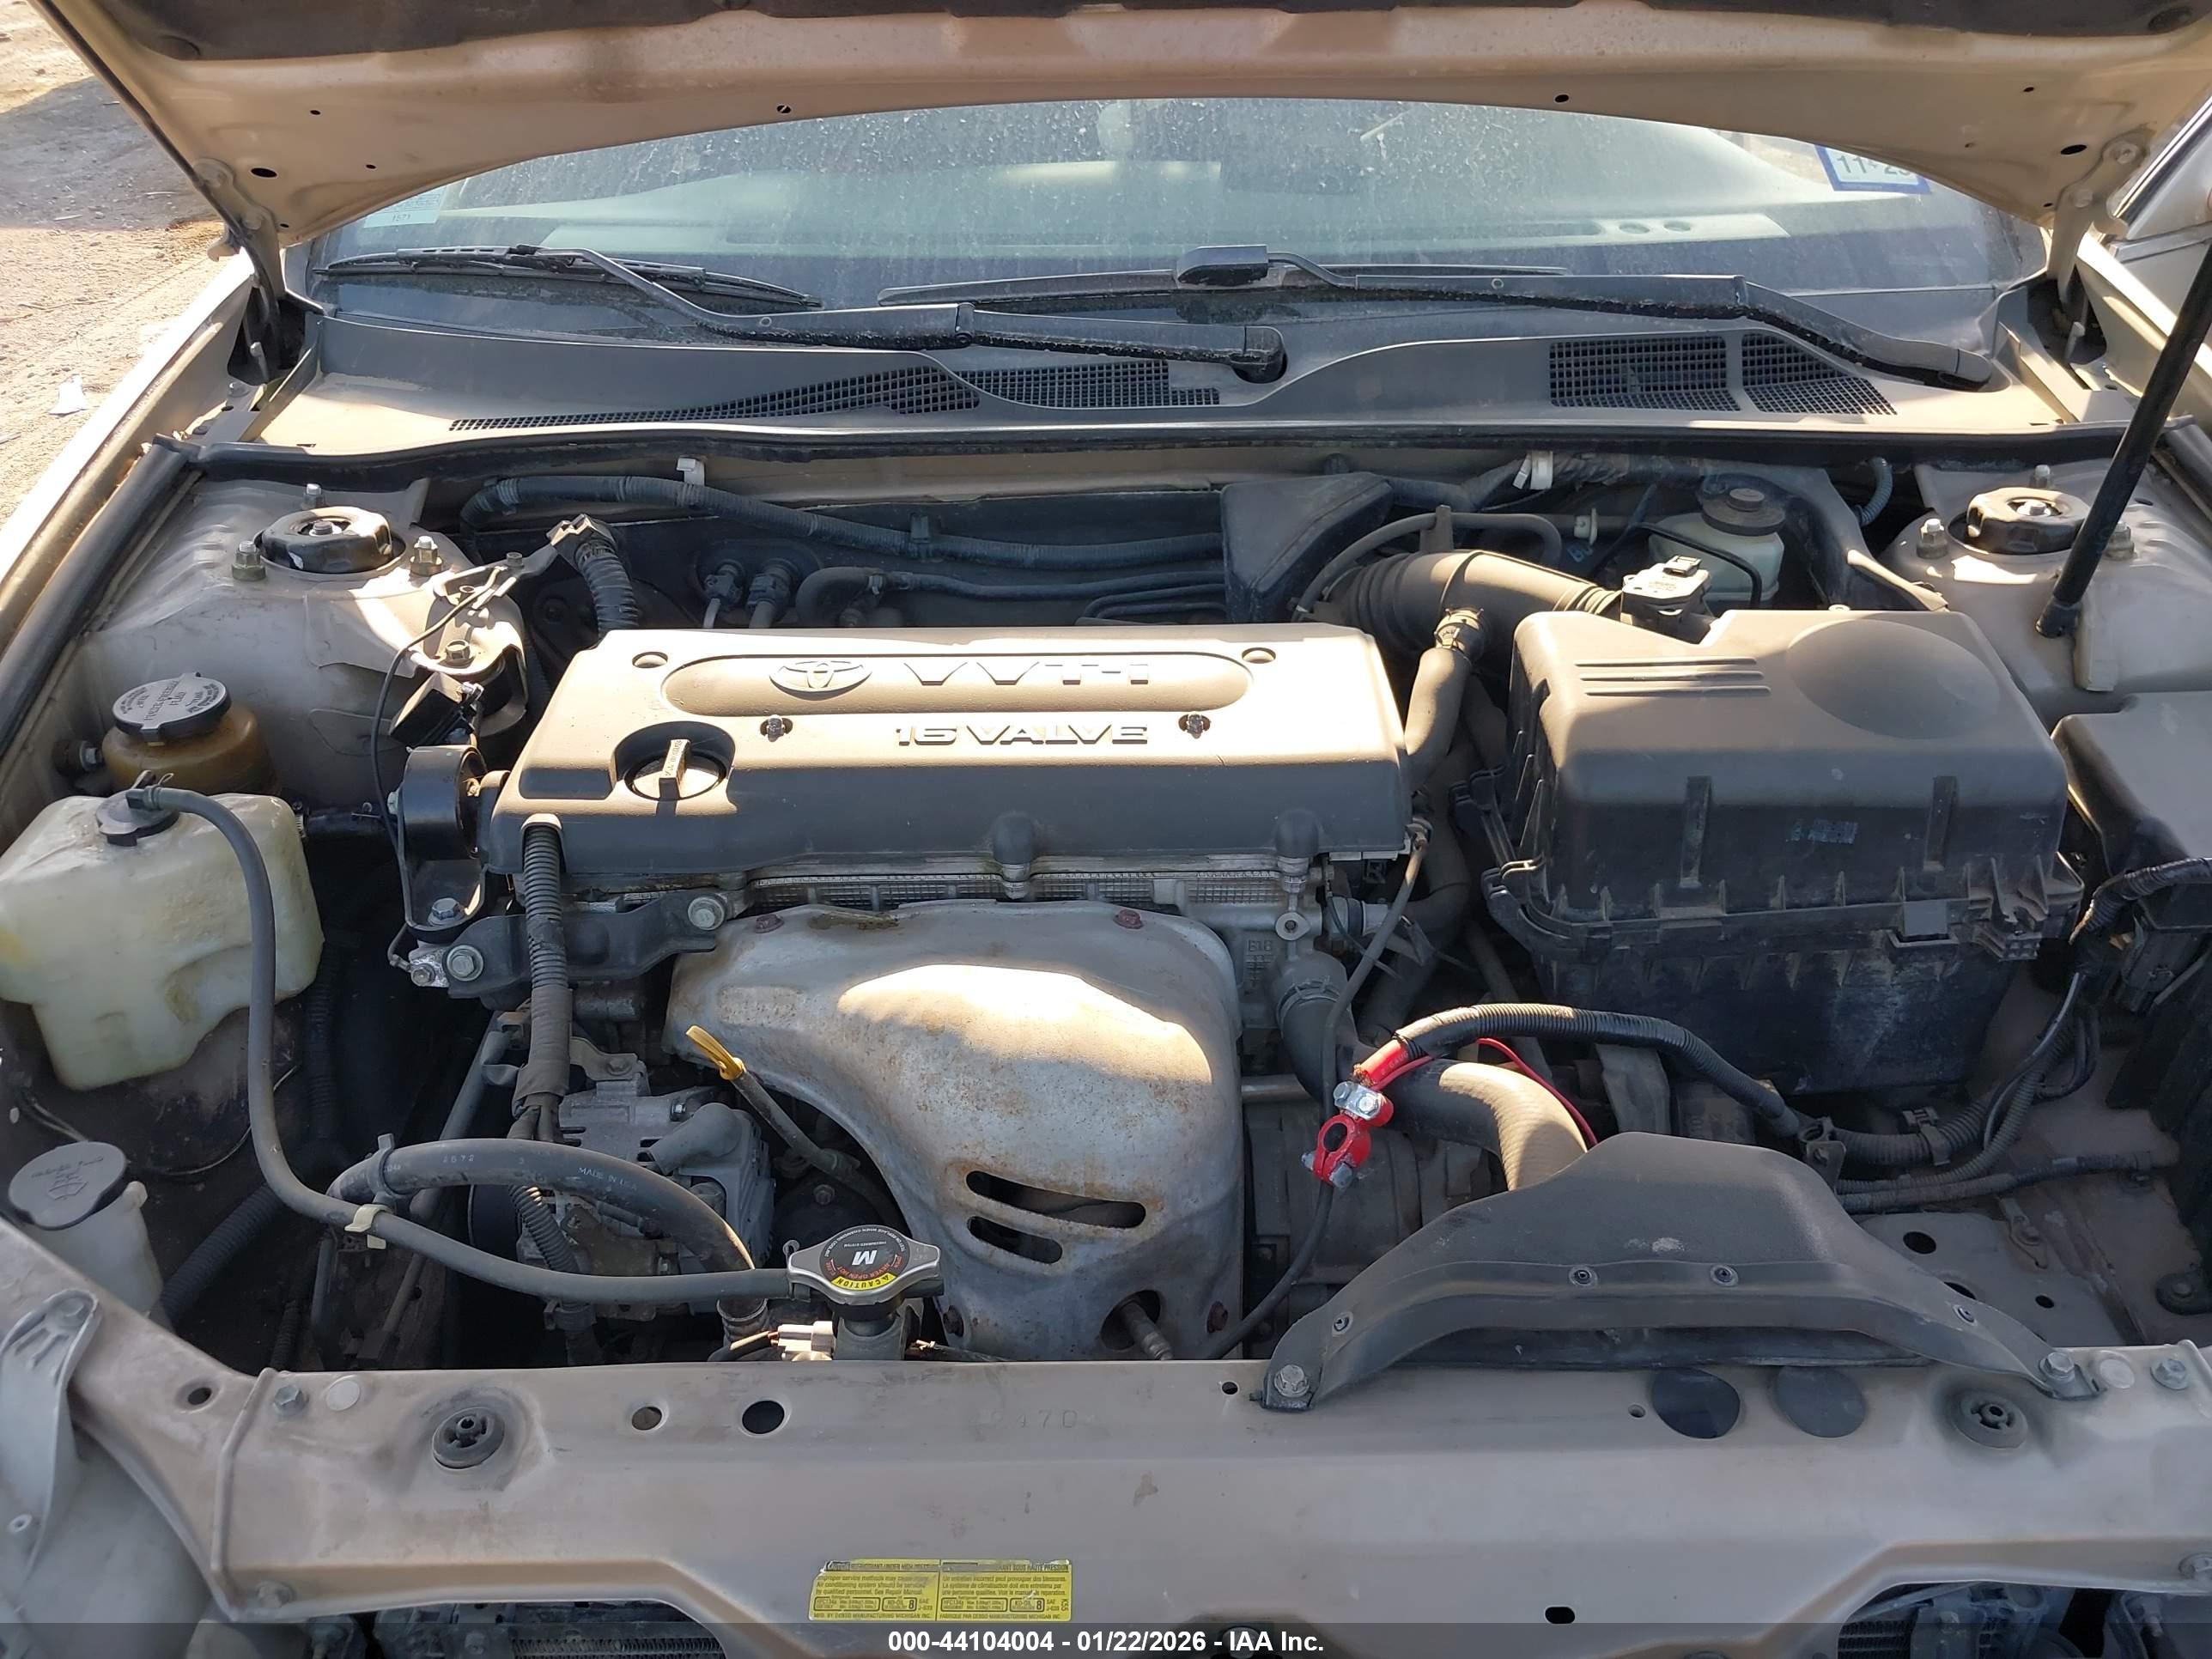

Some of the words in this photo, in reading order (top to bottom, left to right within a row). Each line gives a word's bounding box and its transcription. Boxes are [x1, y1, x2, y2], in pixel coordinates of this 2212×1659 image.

[896, 726, 957, 746] 16
[965, 724, 1149, 745] VALVE
[577, 1167, 605, 1179] MADE
[836, 1276, 882, 1290] CAUTION
[908, 1600, 914, 1609] 8
[1036, 1601, 1042, 1610] 8
